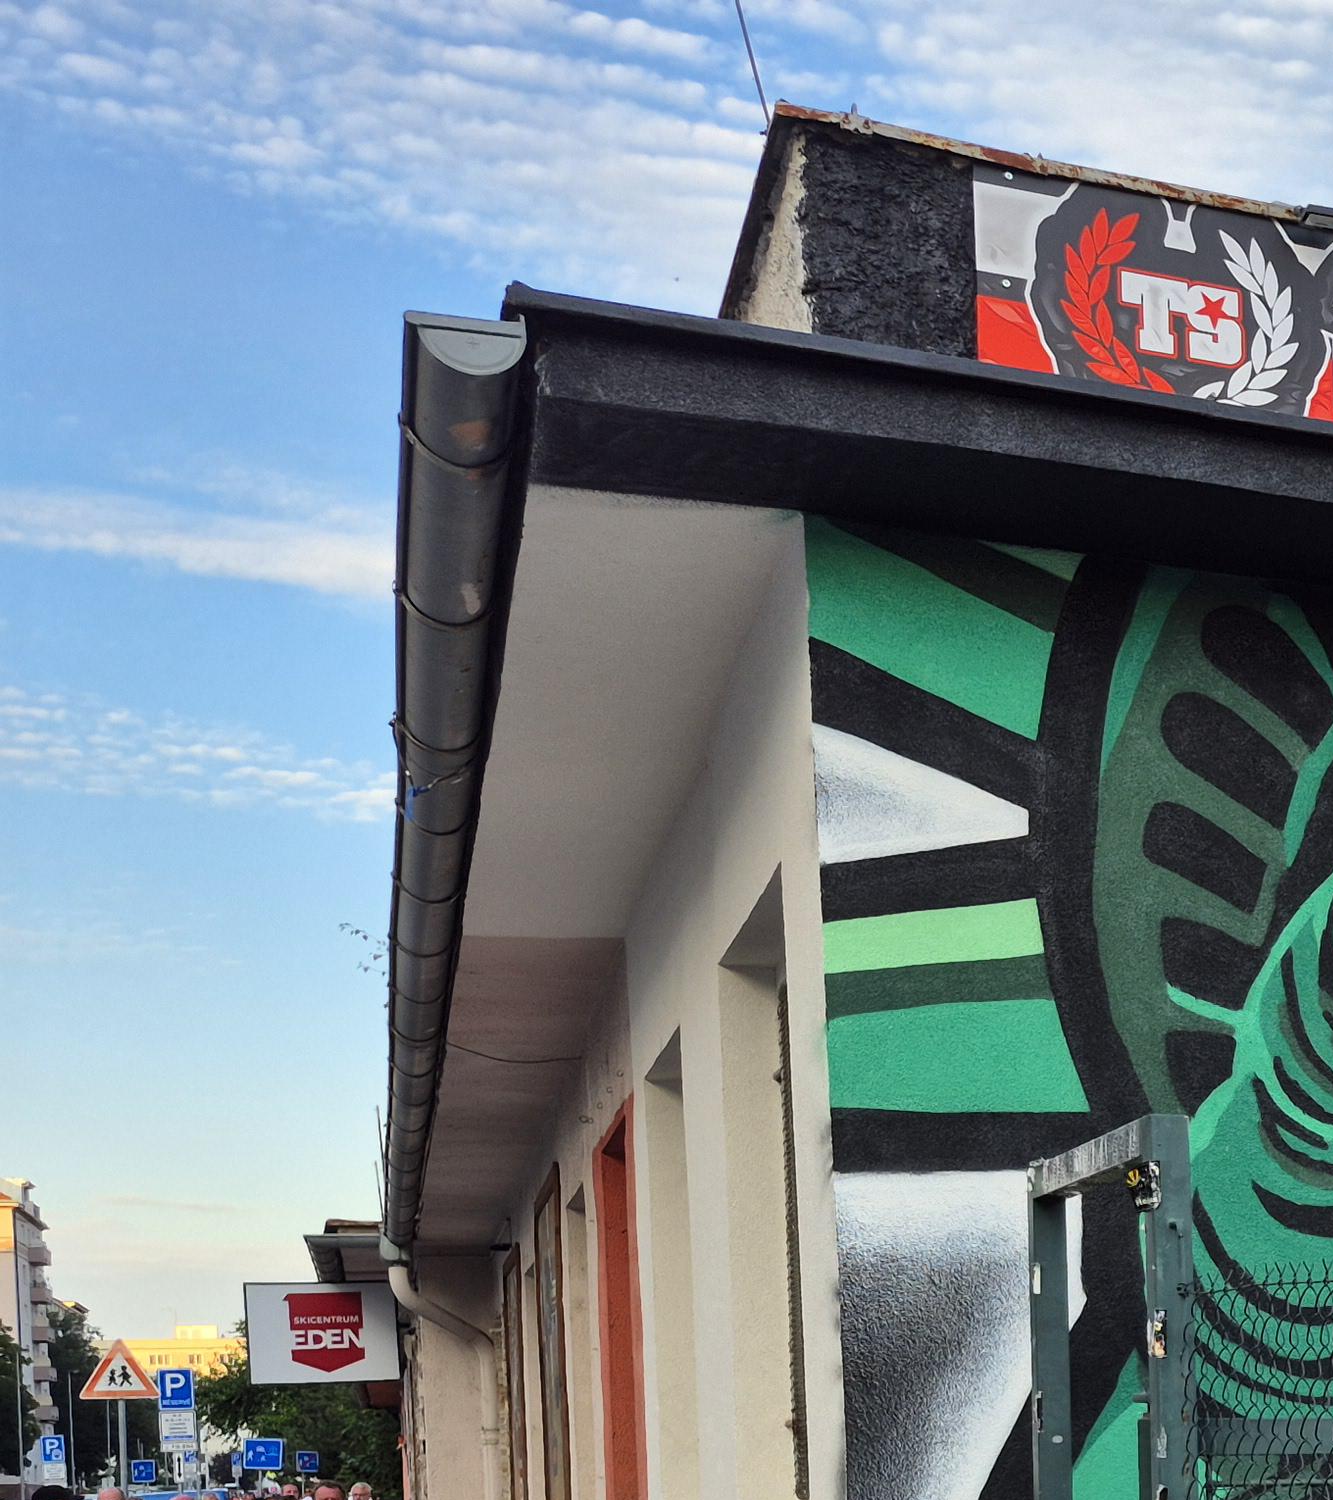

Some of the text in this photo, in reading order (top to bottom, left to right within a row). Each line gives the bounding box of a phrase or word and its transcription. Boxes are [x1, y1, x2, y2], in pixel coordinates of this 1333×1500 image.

[1119, 268, 1244, 367] TS
[293, 1314, 360, 1325] SKICENTRUM
[291, 1328, 365, 1350] EDEN
[165, 1373, 186, 1398] P
[45, 1438, 60, 1456] P
